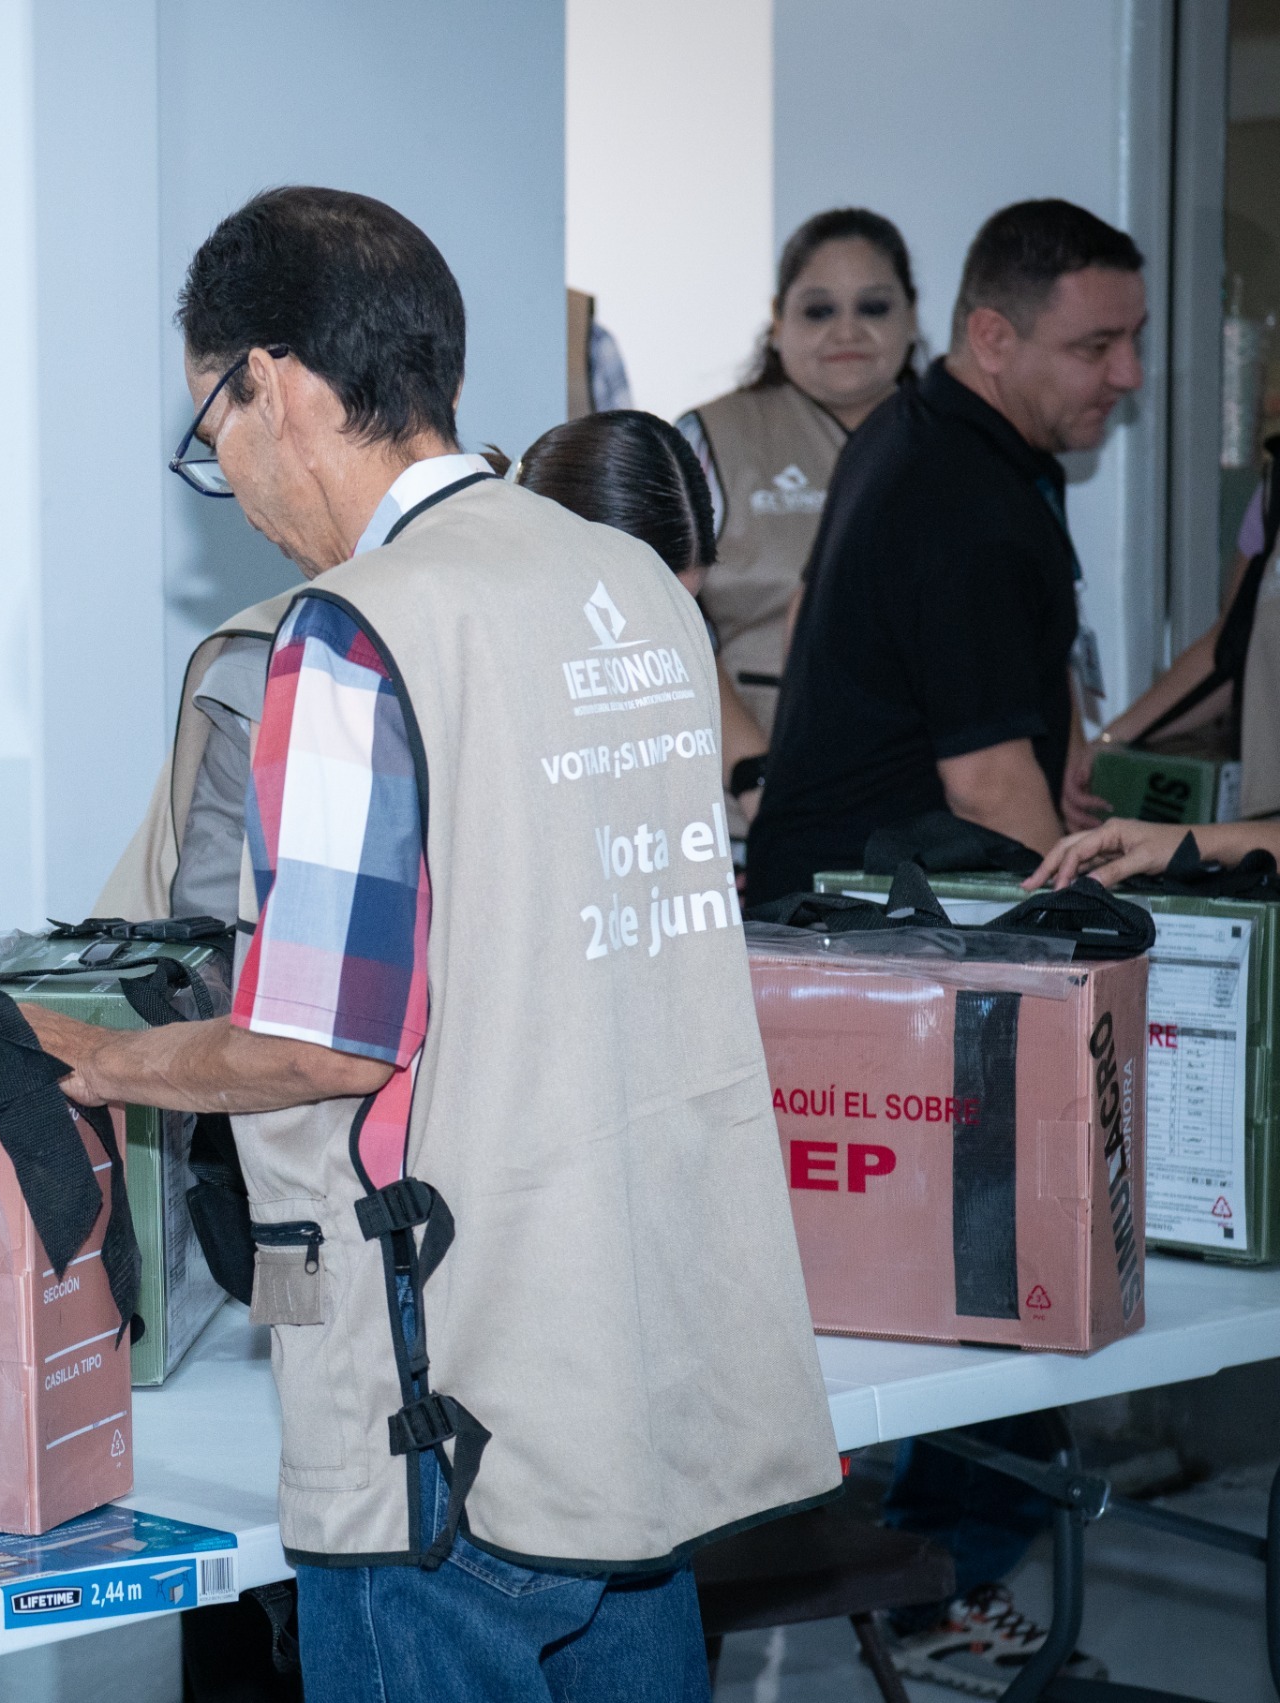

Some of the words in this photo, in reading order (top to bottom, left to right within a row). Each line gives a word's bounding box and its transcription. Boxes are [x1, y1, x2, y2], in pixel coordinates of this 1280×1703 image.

[562, 657, 608, 700] IEE
[606, 647, 690, 696] SONORA
[541, 745, 611, 784] VOTAR
[638, 728, 717, 767] IMPORT
[595, 823, 670, 881] Vota
[681, 802, 728, 862] el
[580, 904, 609, 961] 2
[608, 893, 639, 951] de
[648, 872, 743, 957] juni
[773, 1083, 836, 1118] AQUÍ
[844, 1091, 877, 1119] EL
[885, 1093, 981, 1126] SOBRE
[790, 1139, 898, 1194] EP
[1089, 1010, 1144, 1322] SIMULACRO
[43, 1275, 80, 1305] SECCIÓN
[45, 1362, 80, 1391] CASILLA
[81, 1353, 102, 1378] TIPO
[20, 1590, 75, 1610] LIFETIME
[91, 1580, 124, 1608] 2,44
[127, 1581, 142, 1601] m
